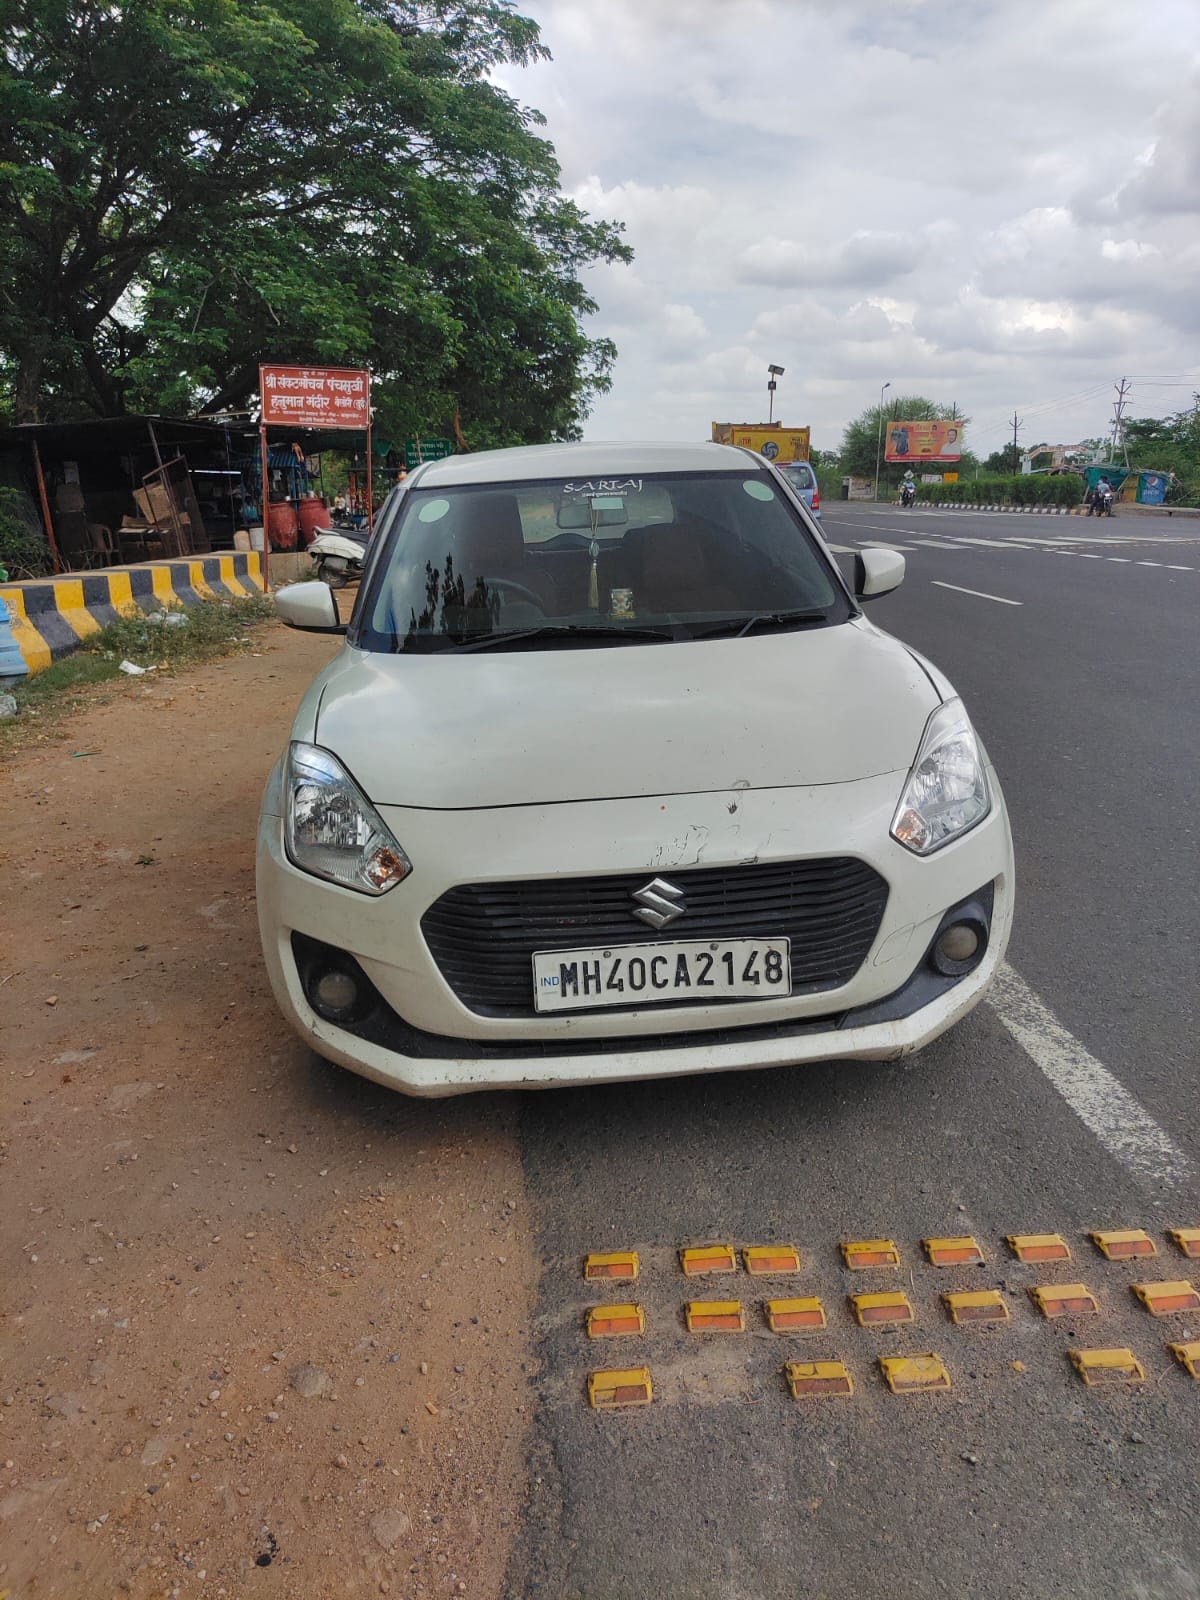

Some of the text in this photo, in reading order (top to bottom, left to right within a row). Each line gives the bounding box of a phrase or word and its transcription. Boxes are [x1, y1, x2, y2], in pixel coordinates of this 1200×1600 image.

[265, 373, 363, 394] श्री संकटमोचन पंचमुखी
[271, 394, 304, 410] हनुमान
[563, 479, 643, 493] SARTAJ
[541, 950, 783, 998] IND MH40CA2148
